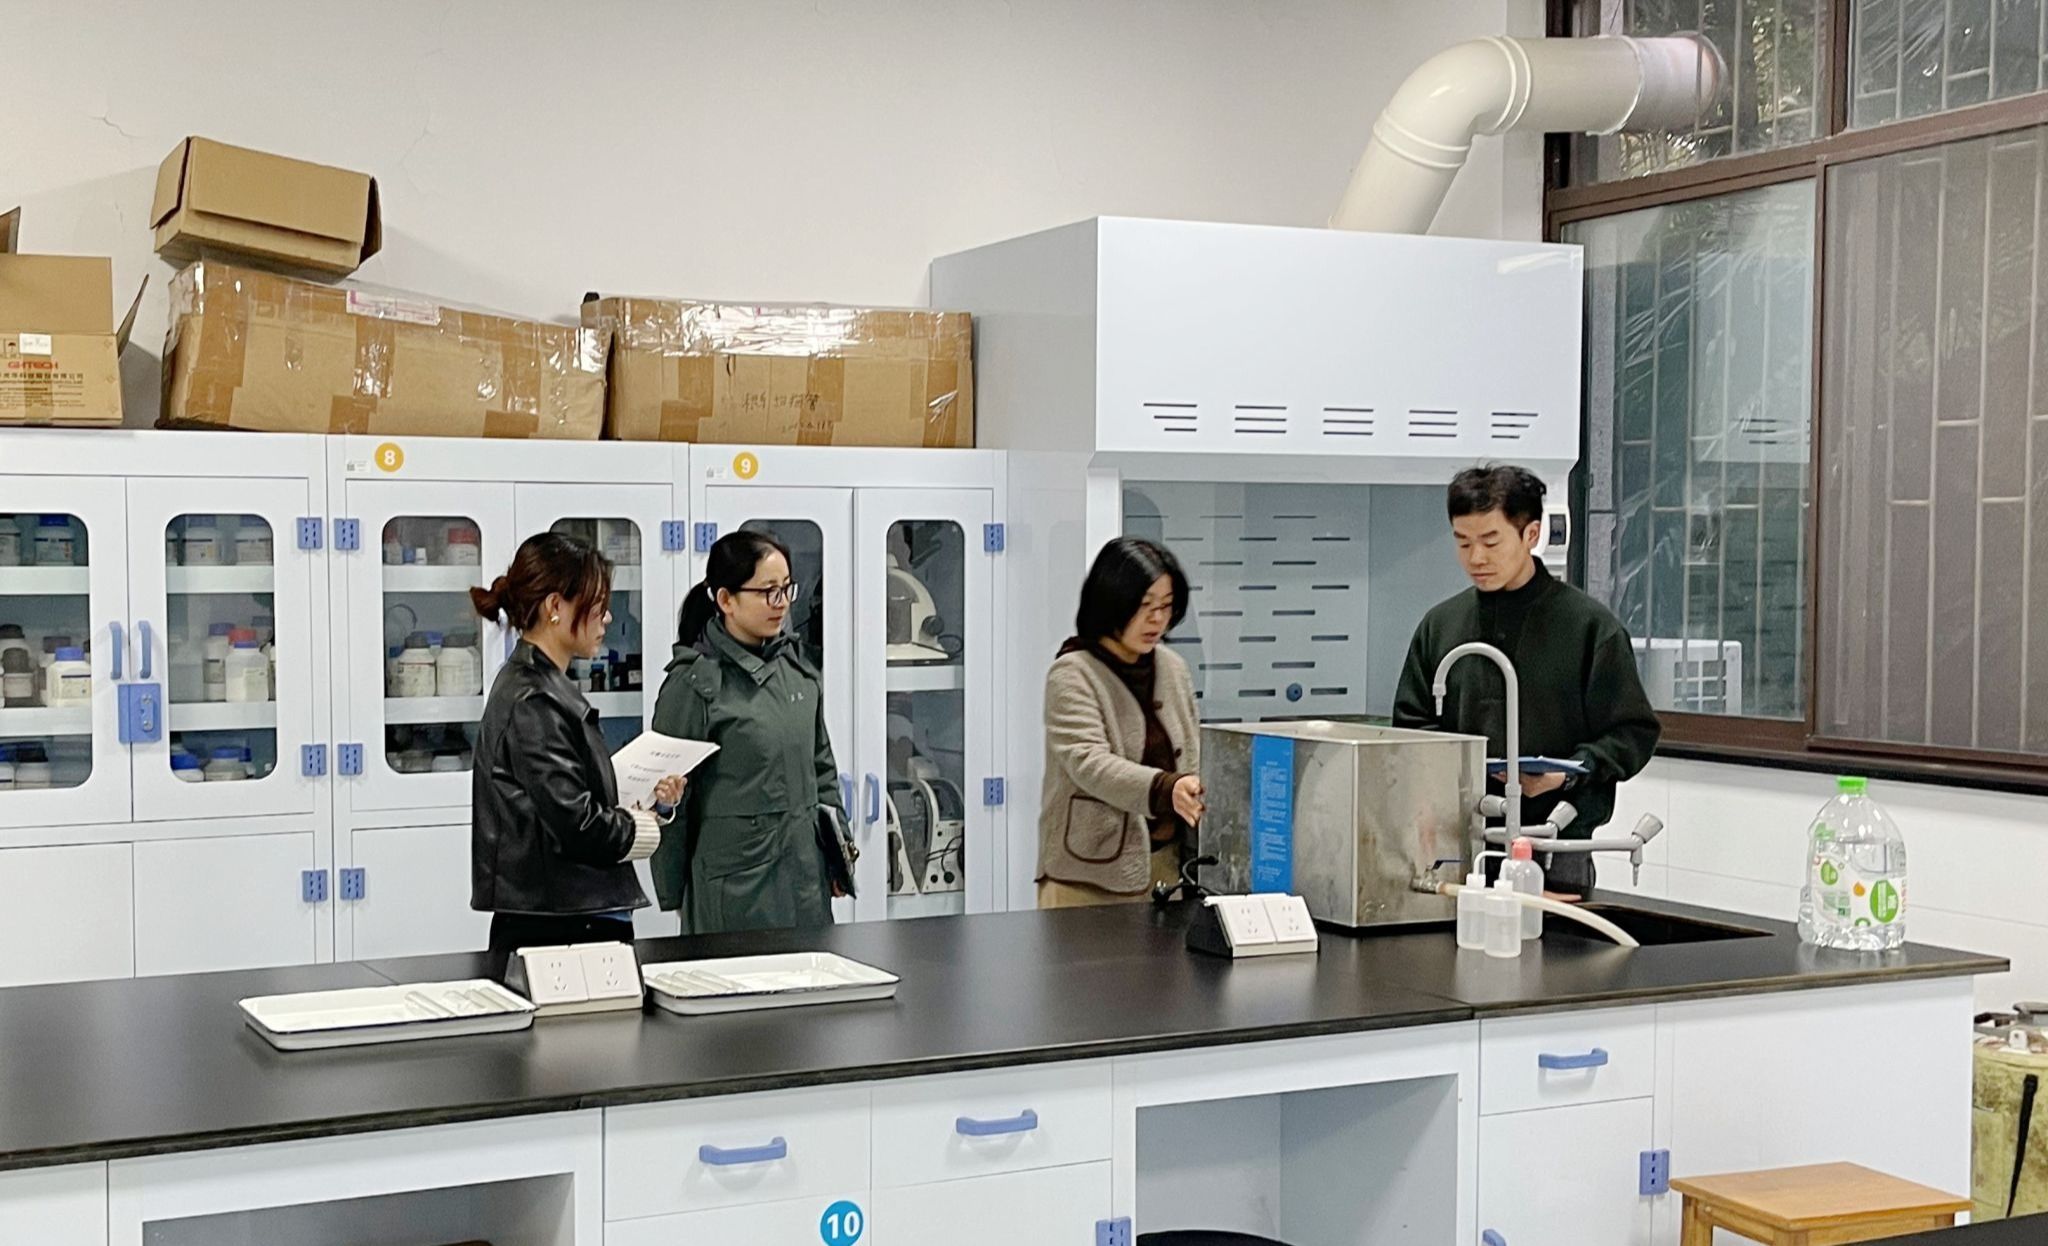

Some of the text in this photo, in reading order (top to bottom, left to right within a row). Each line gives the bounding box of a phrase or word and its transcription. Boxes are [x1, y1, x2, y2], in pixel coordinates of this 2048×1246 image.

[384, 449, 396, 467] 8
[740, 458, 752, 474] 9
[827, 1210, 860, 1240] 10
